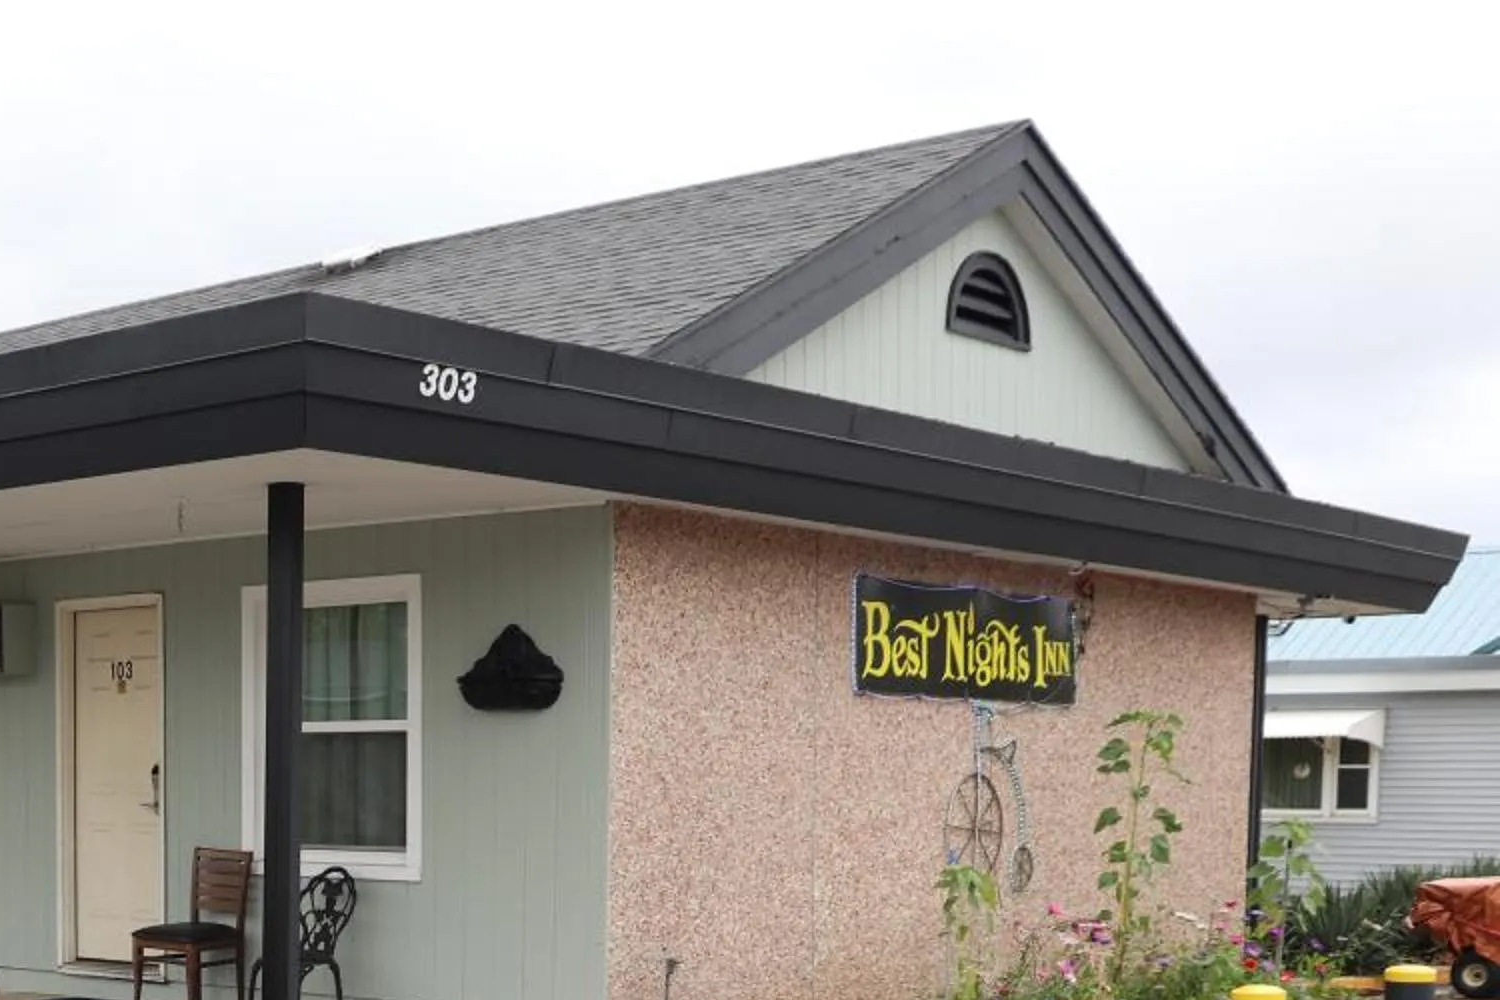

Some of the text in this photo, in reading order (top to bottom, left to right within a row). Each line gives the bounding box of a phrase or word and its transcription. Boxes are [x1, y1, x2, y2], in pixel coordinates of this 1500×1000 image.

[419, 363, 477, 404] 303
[861, 601, 940, 680] Best
[941, 601, 1030, 687] Nights
[111, 660, 133, 681] 103
